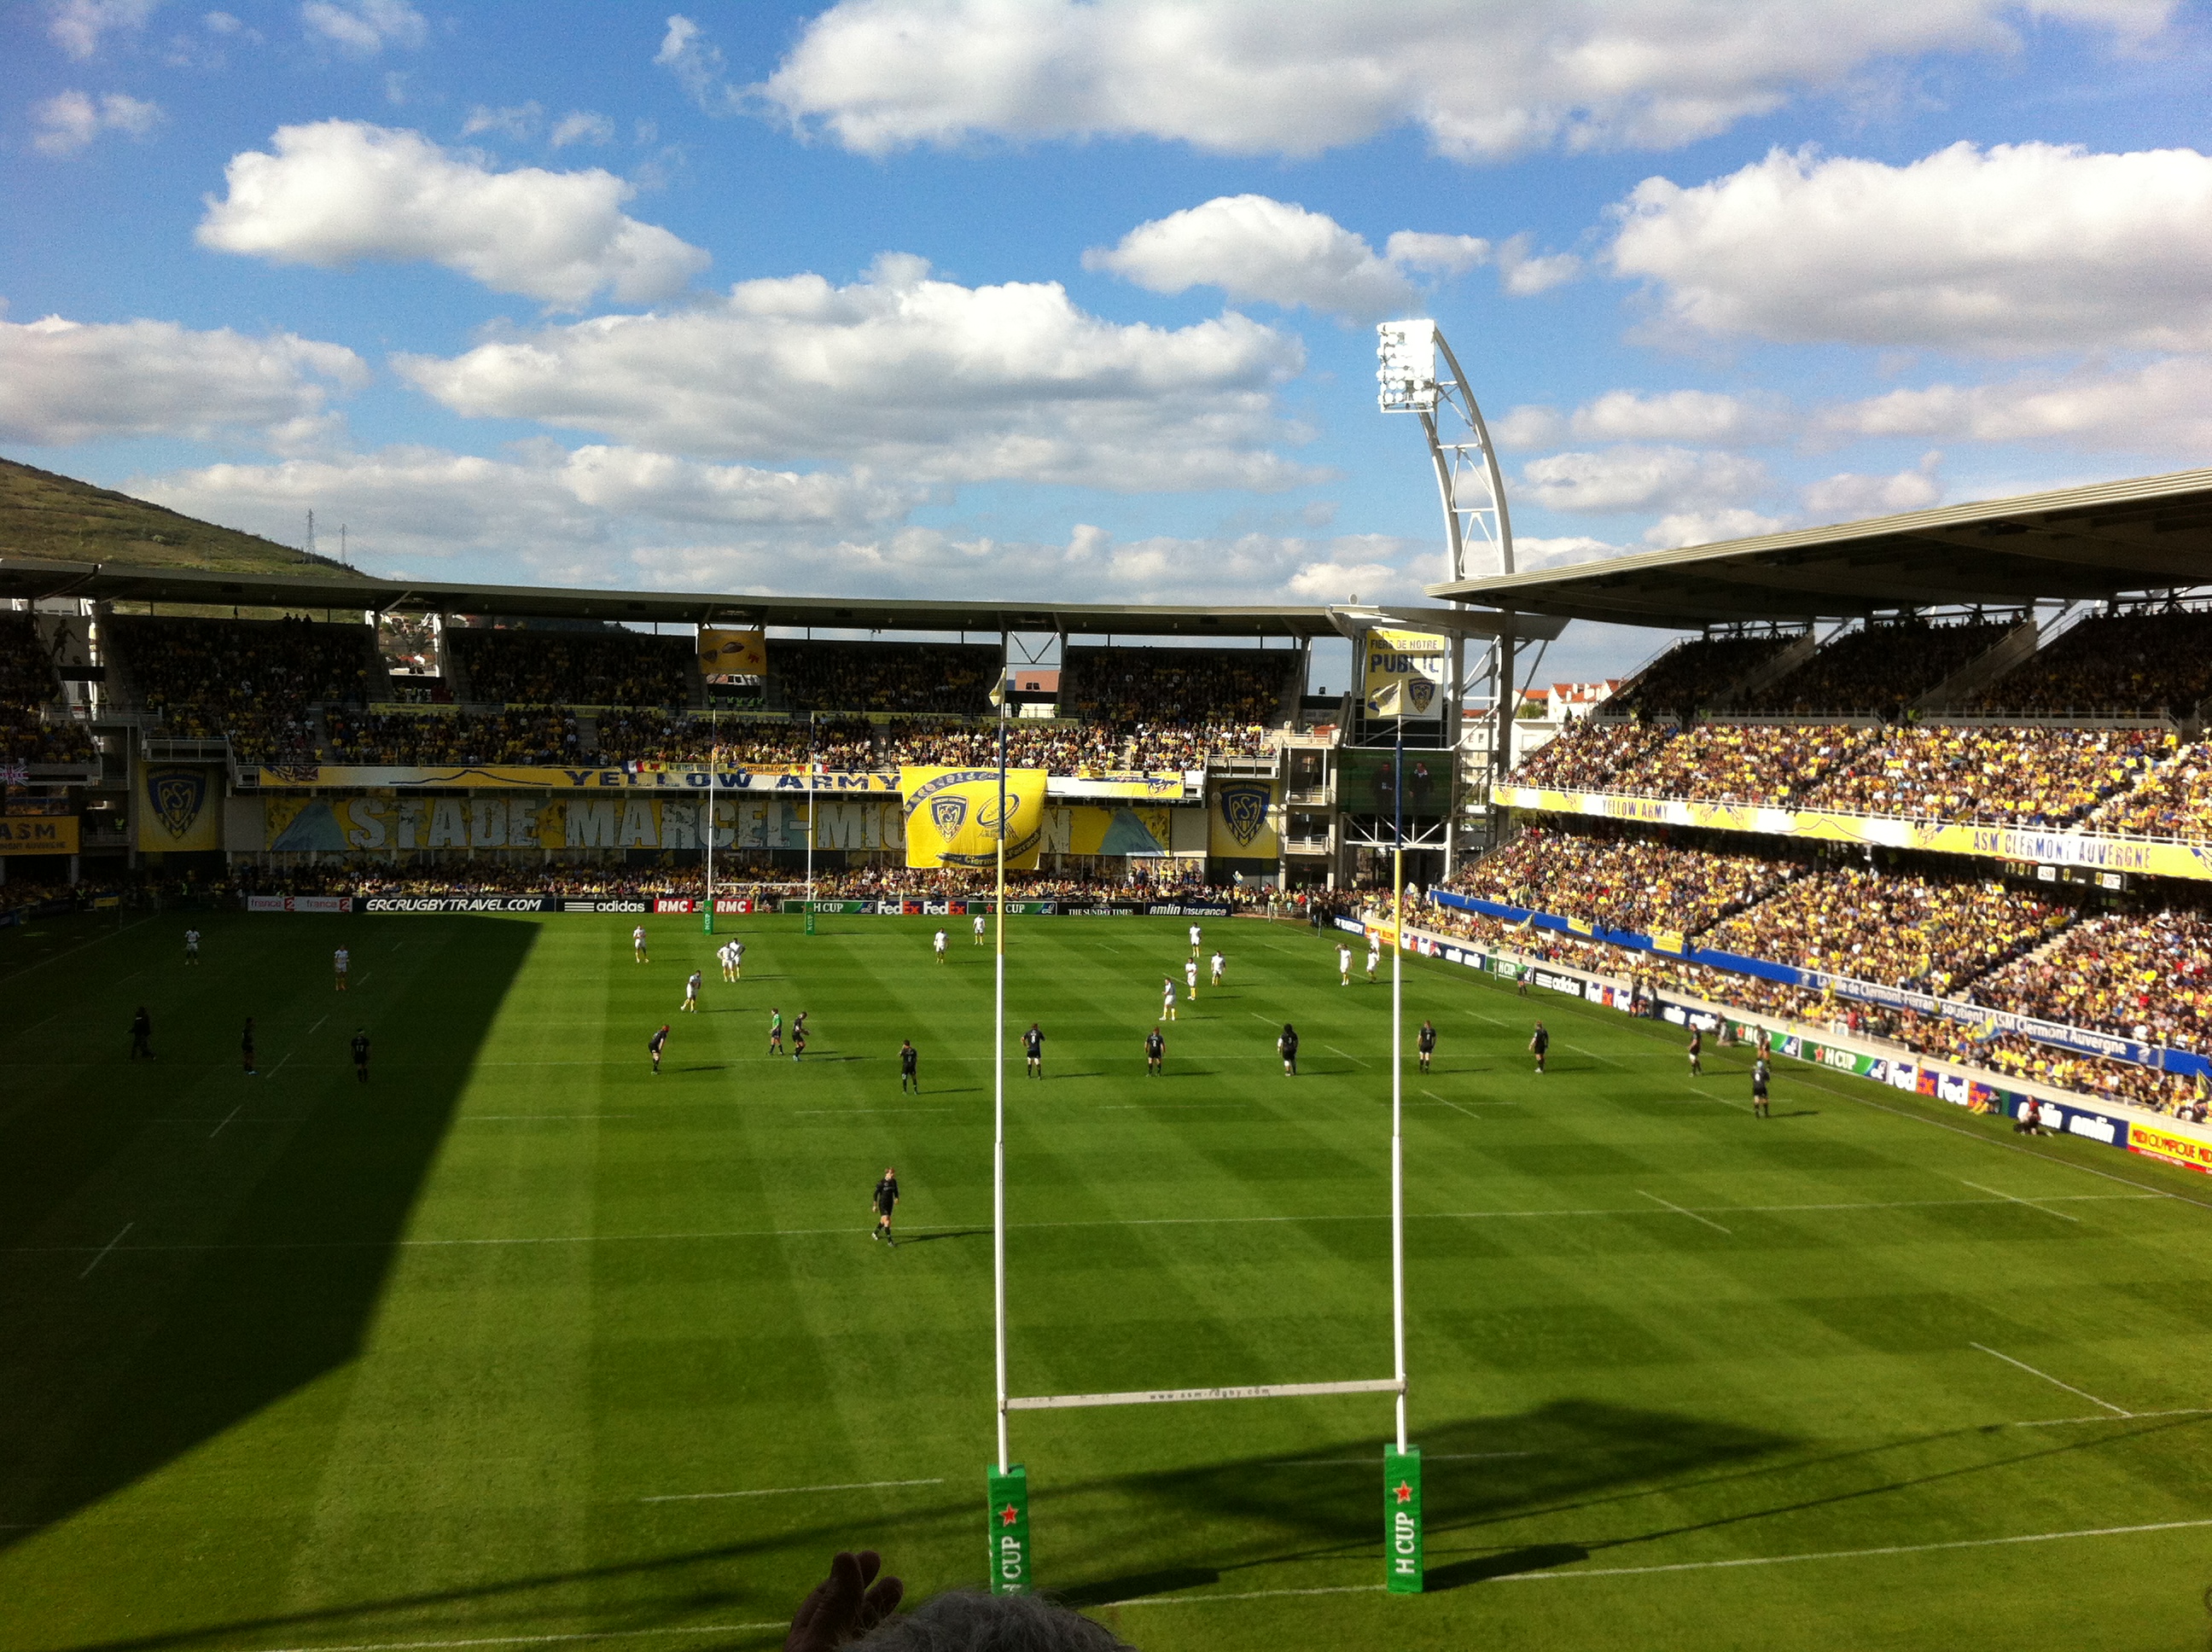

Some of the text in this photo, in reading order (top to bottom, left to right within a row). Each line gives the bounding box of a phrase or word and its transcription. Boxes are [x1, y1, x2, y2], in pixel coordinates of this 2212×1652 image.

[1396, 640, 1407, 649] DE
[1410, 640, 1438, 649] NOTRE
[1371, 654, 1440, 673] PUBLIC
[563, 769, 902, 792] YELLOW ARMY
[1602, 799, 1668, 819] YELLOW ARMY
[348, 798, 537, 849] STADE
[1973, 830, 2151, 870] ASM CLERMONT AUVERGNE
[251, 899, 282, 908] france
[306, 899, 337, 909] france
[366, 899, 542, 912] ERCRUGBYTRAVEL.COM
[597, 898, 645, 912] adidas
[657, 900, 689, 912] RMC
[716, 900, 748, 912] RMC
[813, 903, 844, 913] H CUP
[877, 901, 920, 915] FedEx
[923, 901, 965, 915] FedEx
[1005, 904, 1025, 913] CUP
[1150, 903, 1181, 916] amlin
[1113, 908, 1134, 916] TIMES
[1552, 976, 1580, 997] adidas
[2016, 1017, 2069, 1042] Clermont
[2069, 1030, 2128, 1056] Auvergne
[1825, 1048, 1857, 1071] H CUP
[1889, 1061, 1937, 1096] FedEx
[1394, 1511, 1416, 1575] H CUP
[1001, 1536, 1022, 1579] CUP
